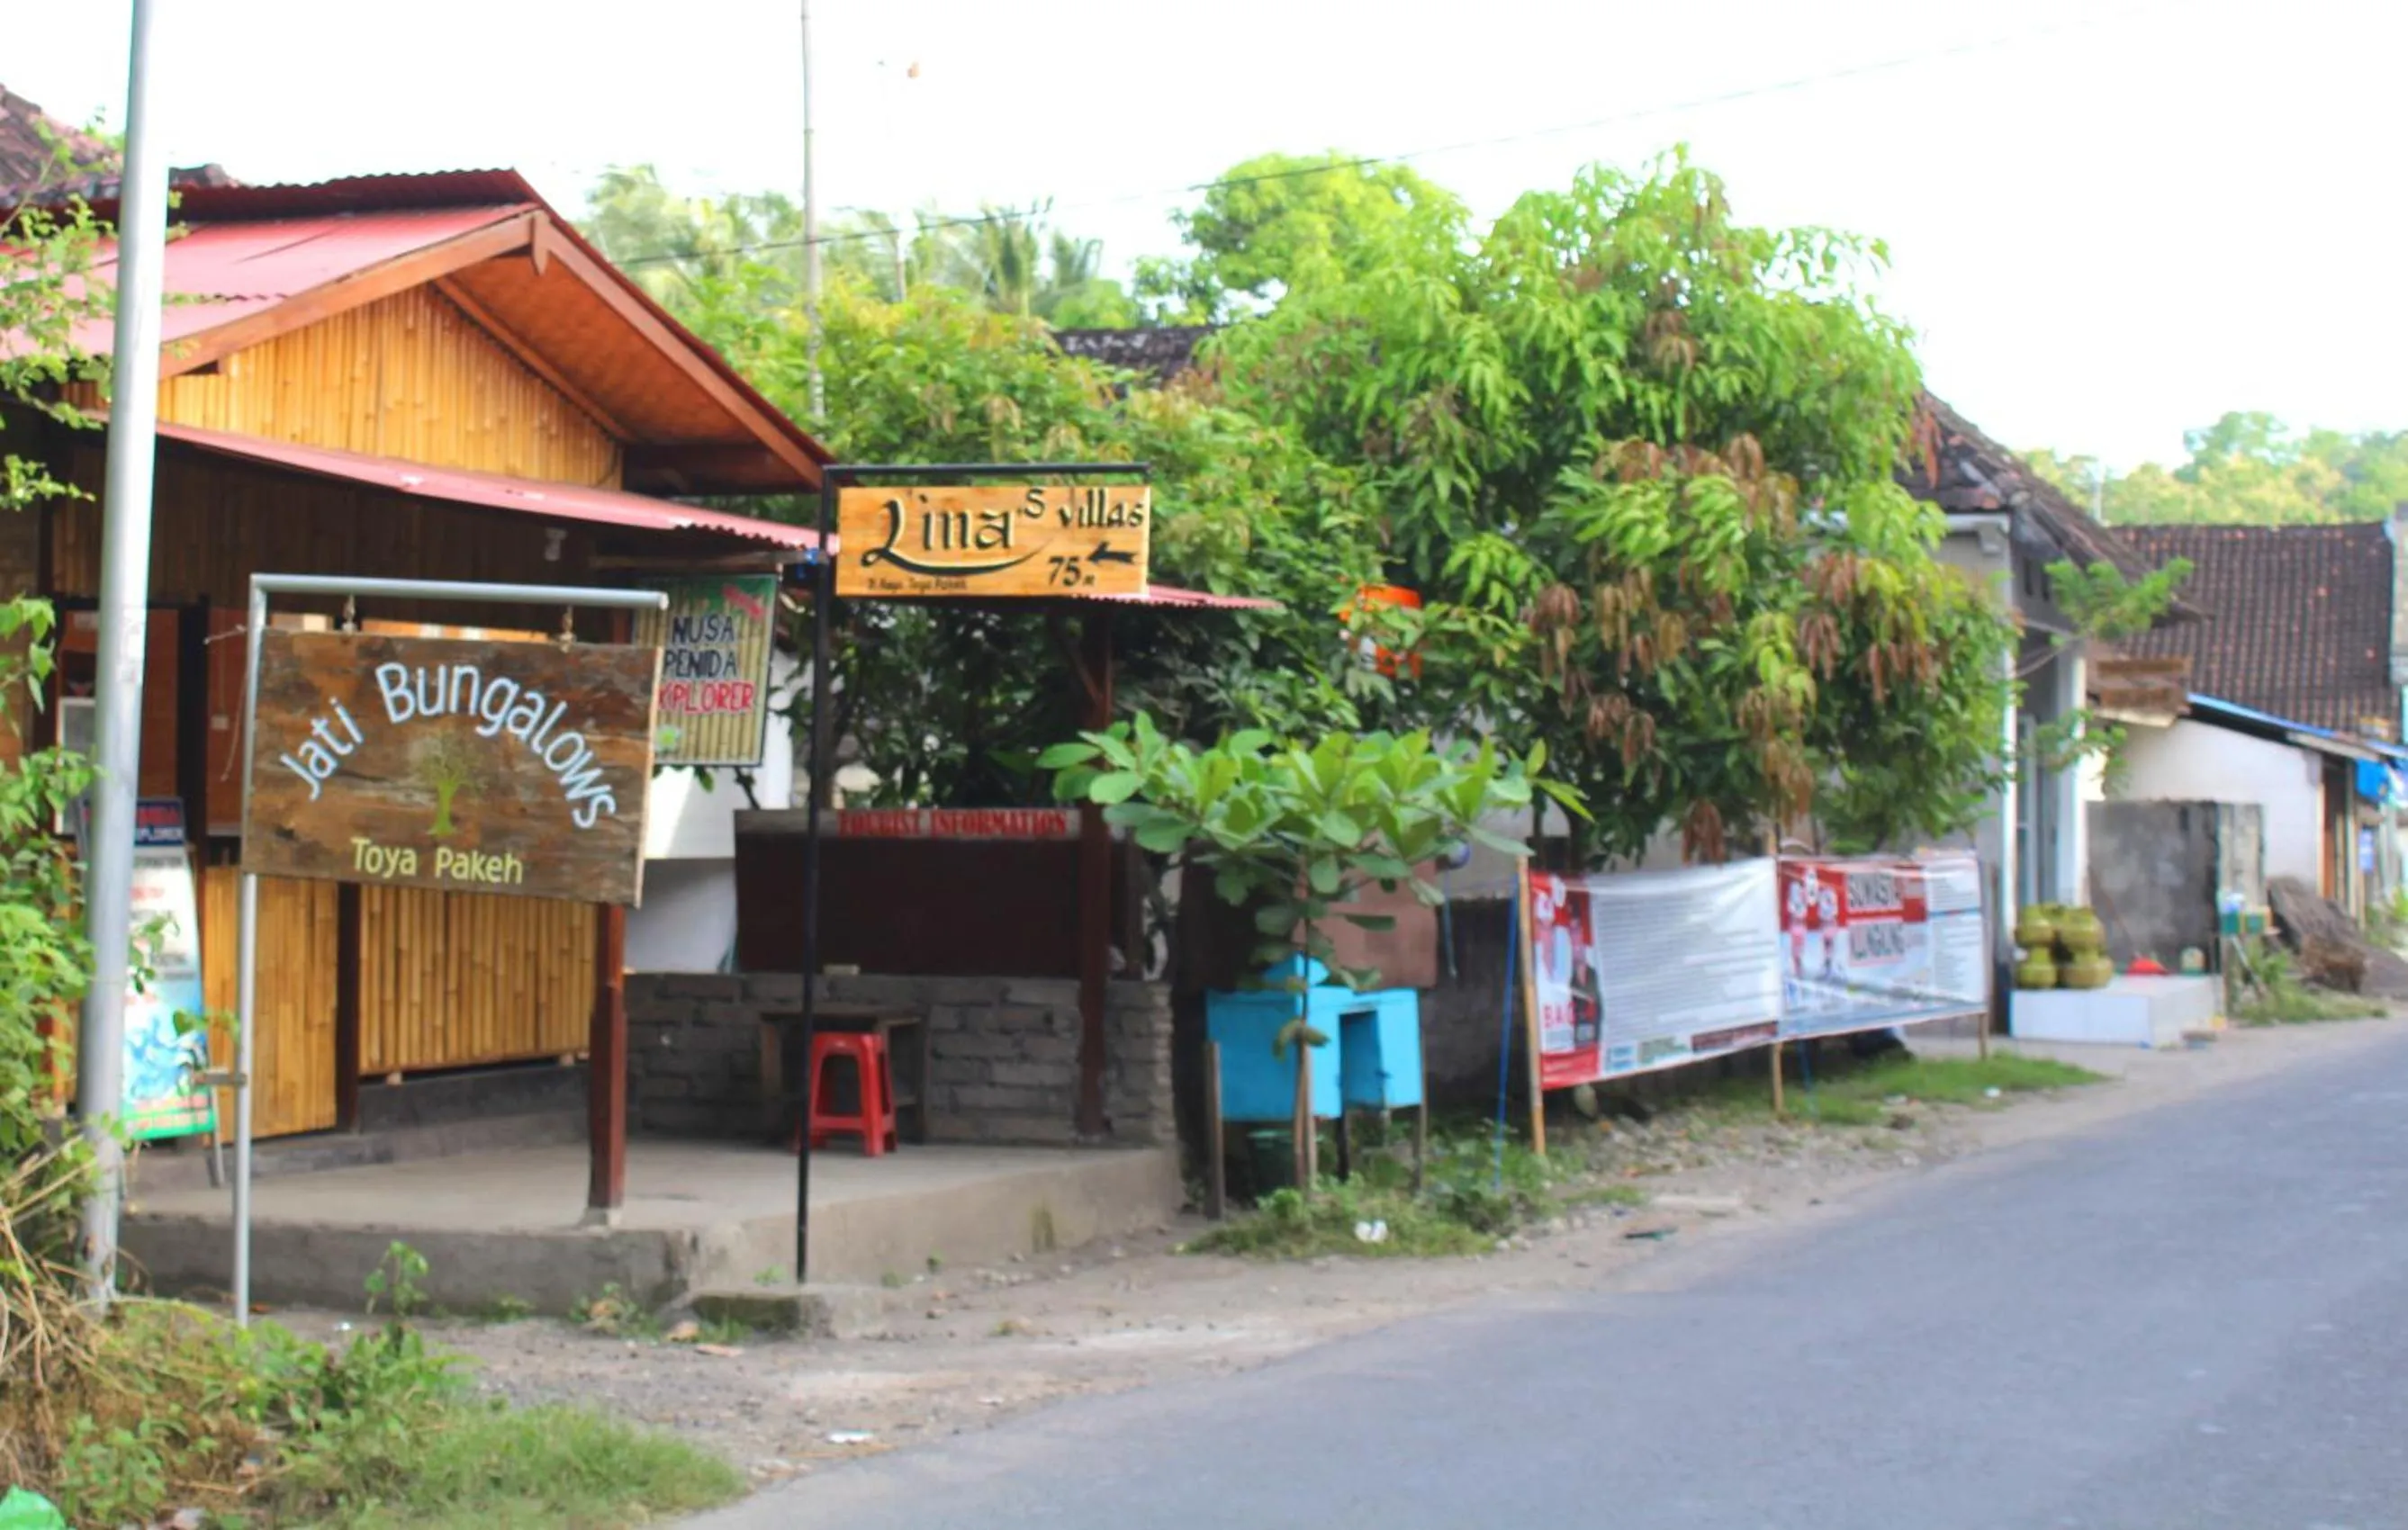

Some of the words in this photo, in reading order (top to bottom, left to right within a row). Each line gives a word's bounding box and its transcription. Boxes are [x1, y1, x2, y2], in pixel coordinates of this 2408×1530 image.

[672, 616, 735, 643] NUSA
[280, 697, 364, 801] Jati
[375, 662, 616, 829] Bungalows
[351, 837, 417, 879] Toya
[435, 850, 523, 884] Pakeh
